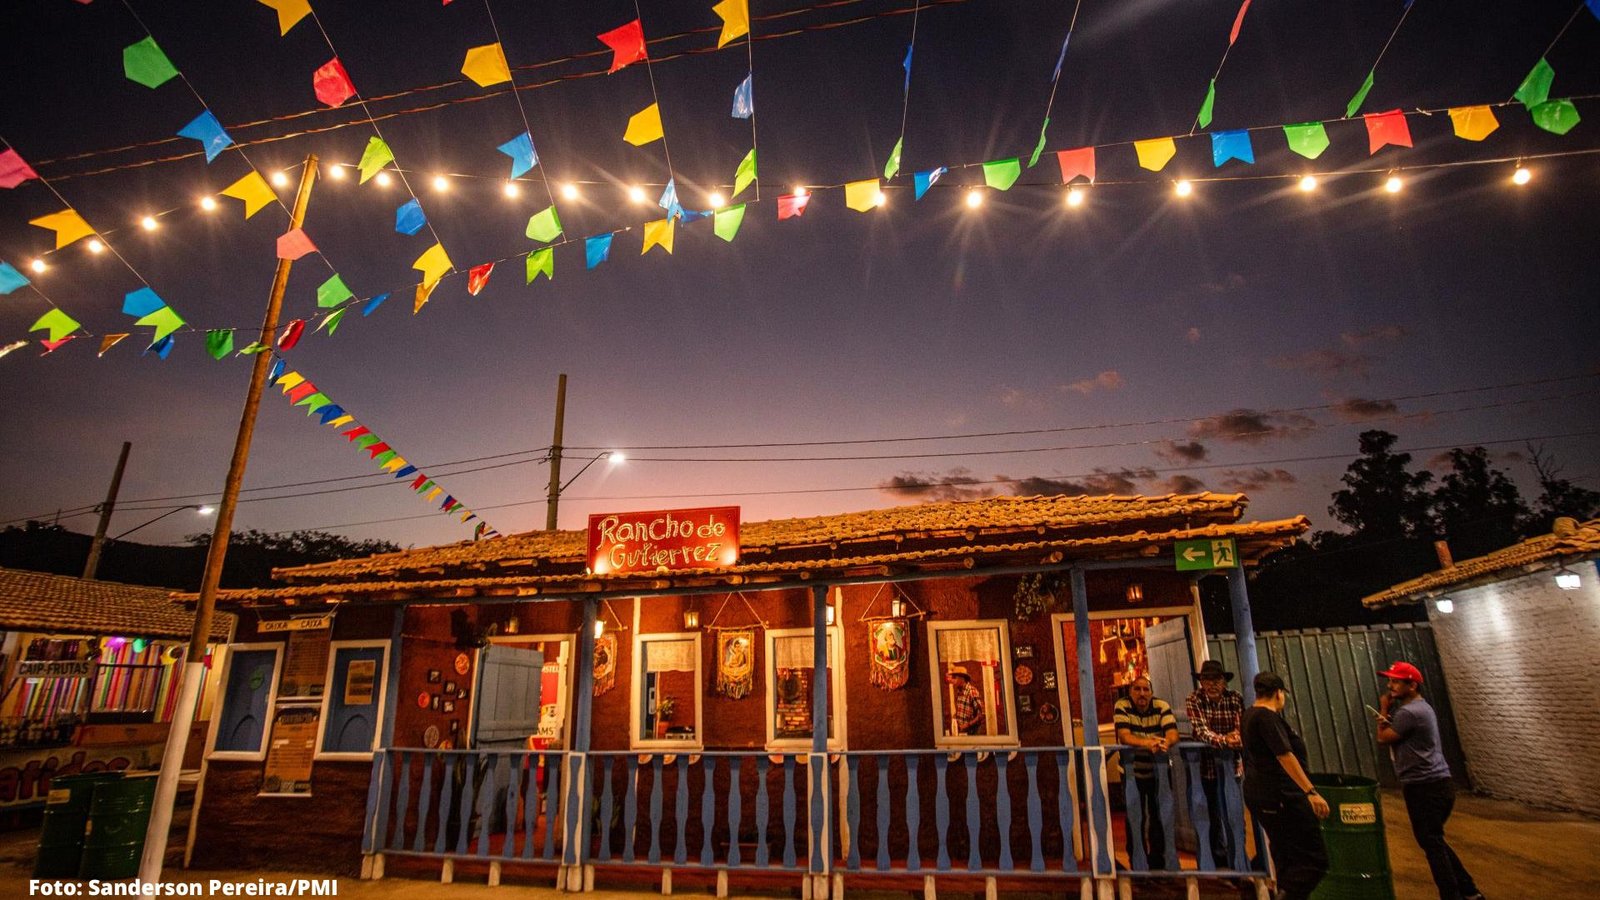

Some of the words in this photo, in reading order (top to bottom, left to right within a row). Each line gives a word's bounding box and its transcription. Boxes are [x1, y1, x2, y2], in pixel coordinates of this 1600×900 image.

[596, 513, 694, 550] Rancho
[609, 542, 722, 569] Gutierrez
[265, 622, 288, 631] CAIXA
[301, 619, 322, 629] CAIXA
